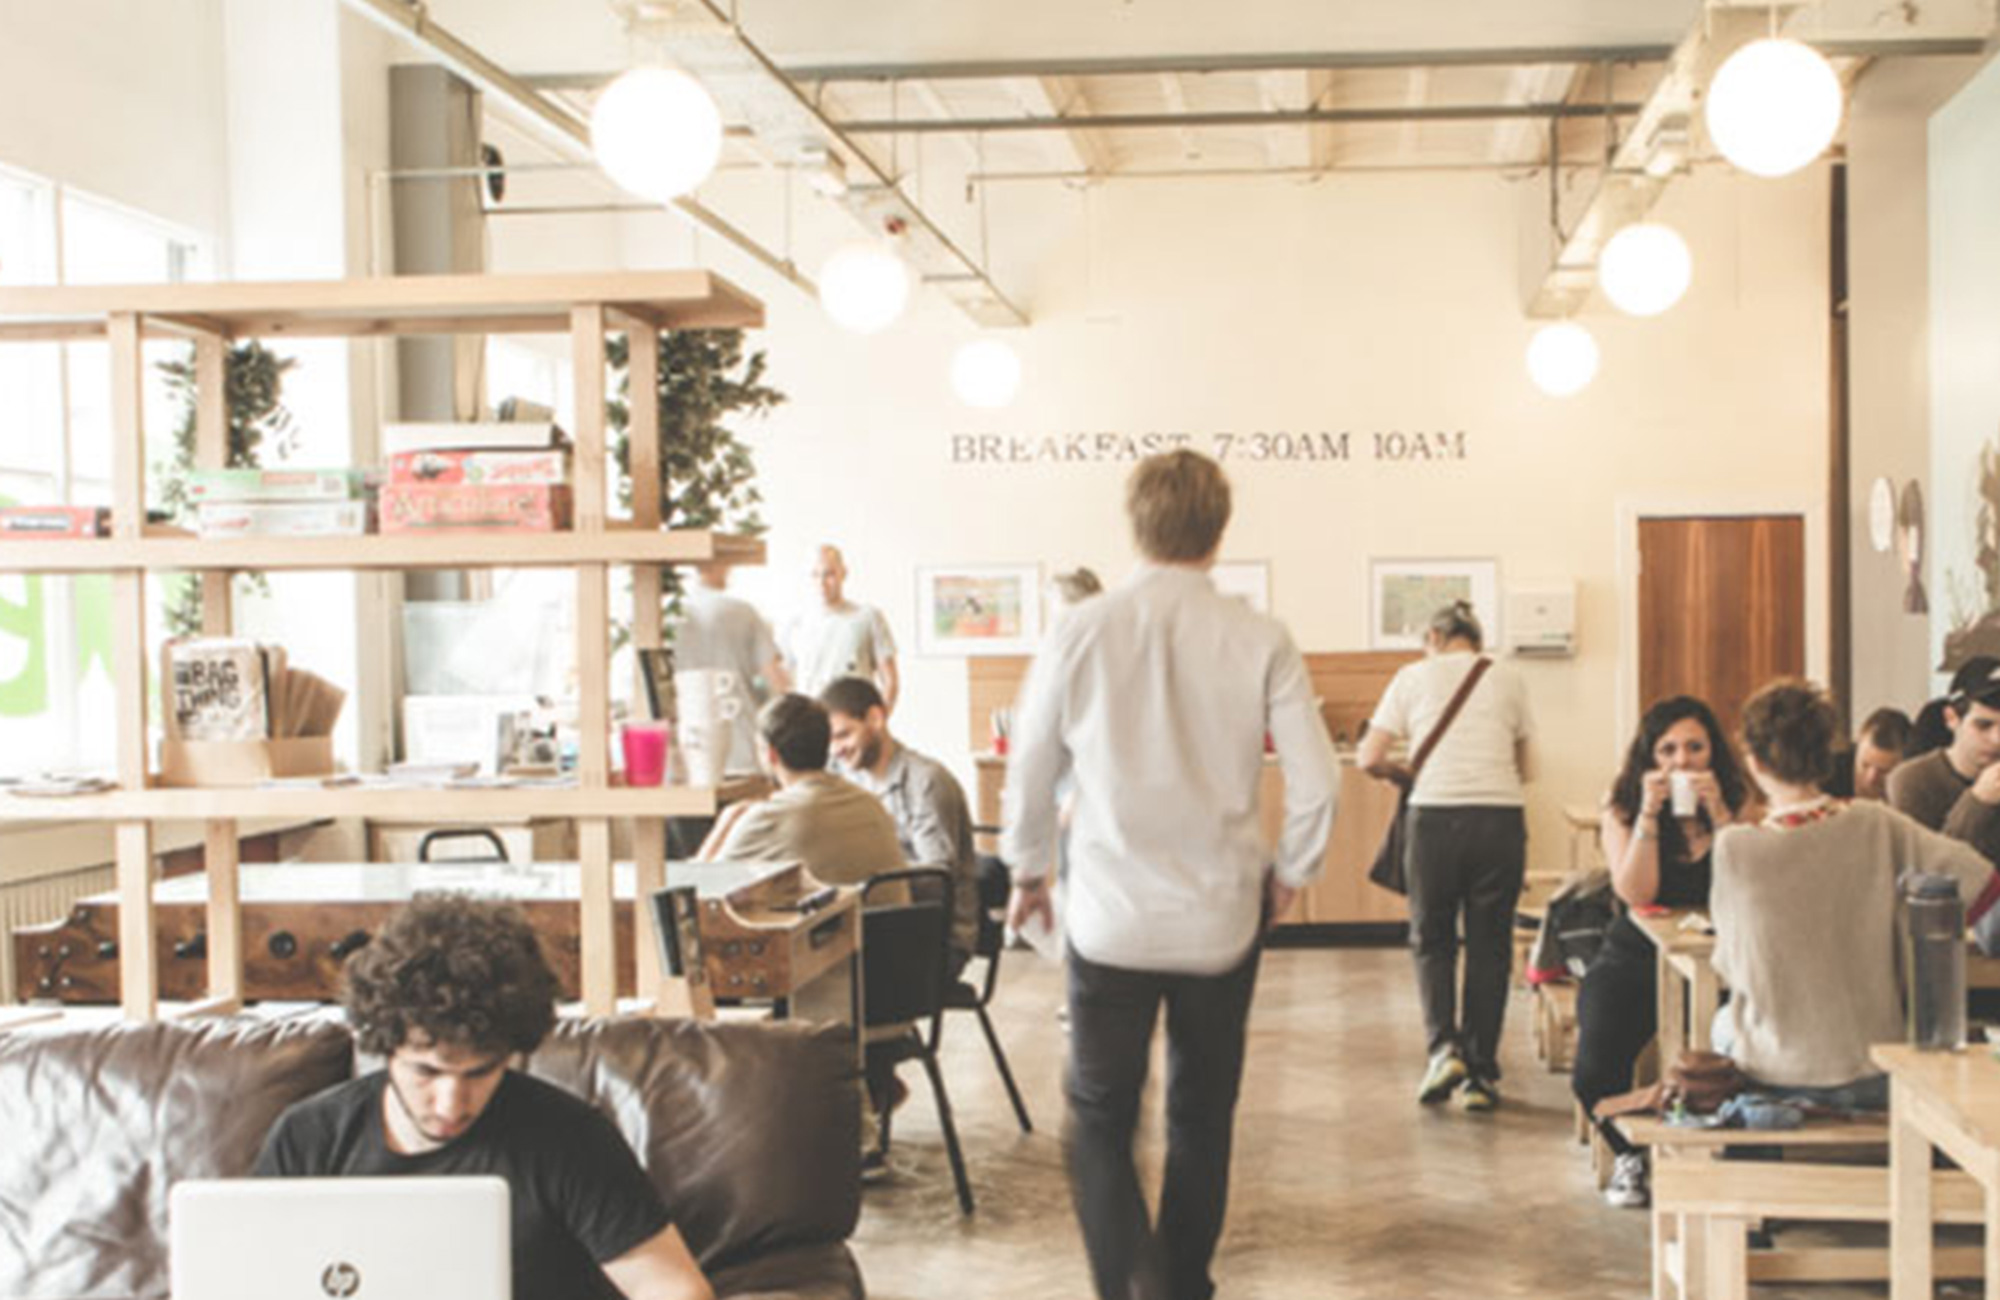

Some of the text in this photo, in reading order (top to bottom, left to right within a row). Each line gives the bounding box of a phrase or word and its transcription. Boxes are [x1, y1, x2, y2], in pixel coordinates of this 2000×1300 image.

[951, 431, 1466, 463] BREAKFAST 7:30AM 10AM
